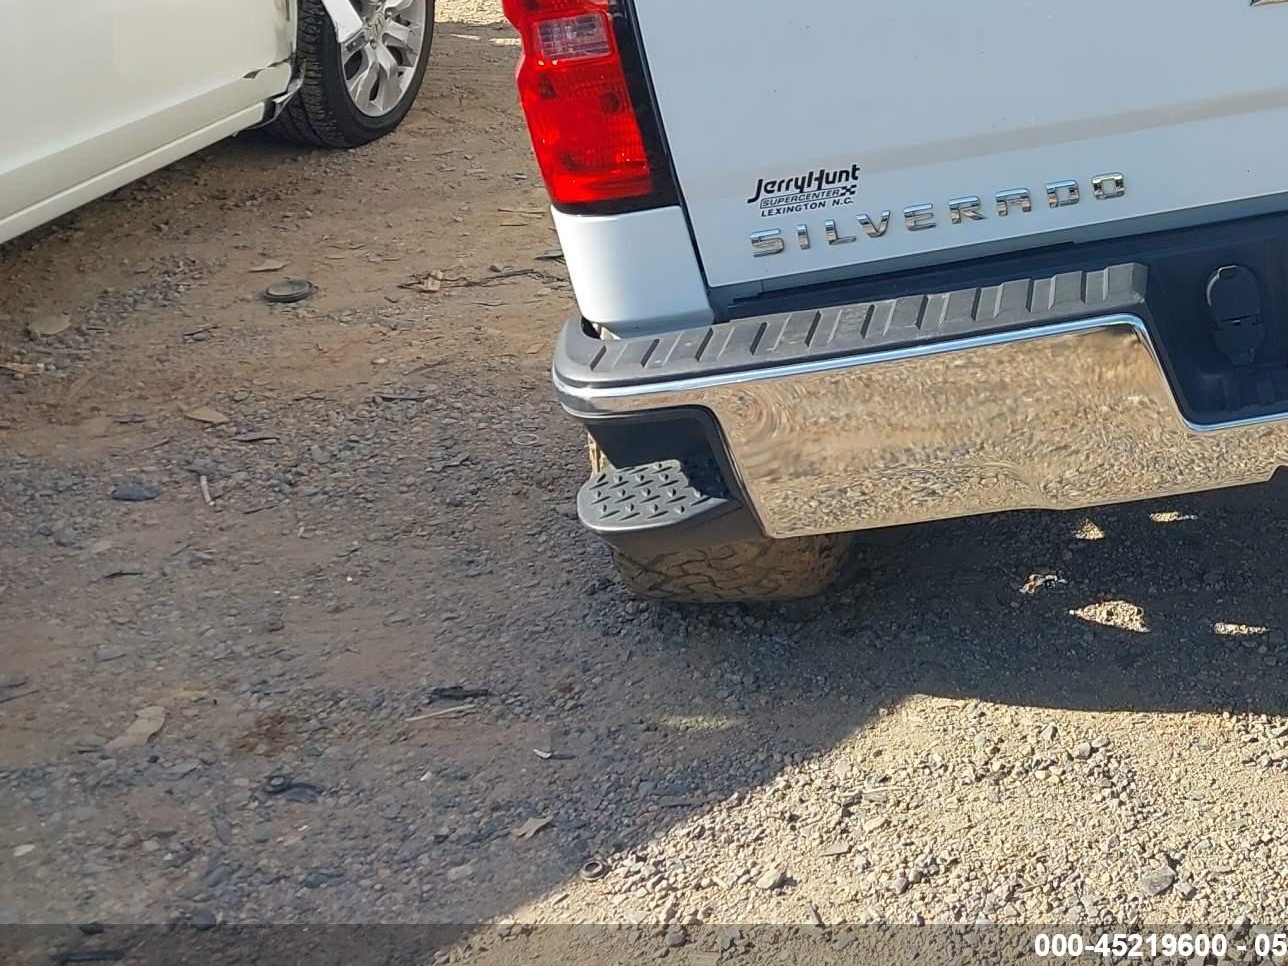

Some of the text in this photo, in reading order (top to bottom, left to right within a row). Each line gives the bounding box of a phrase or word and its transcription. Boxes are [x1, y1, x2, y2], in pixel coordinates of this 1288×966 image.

[762, 188, 841, 207] SUPERCENTER
[751, 172, 1125, 258] SILVERADO
[761, 201, 827, 217] LEXINGTON
